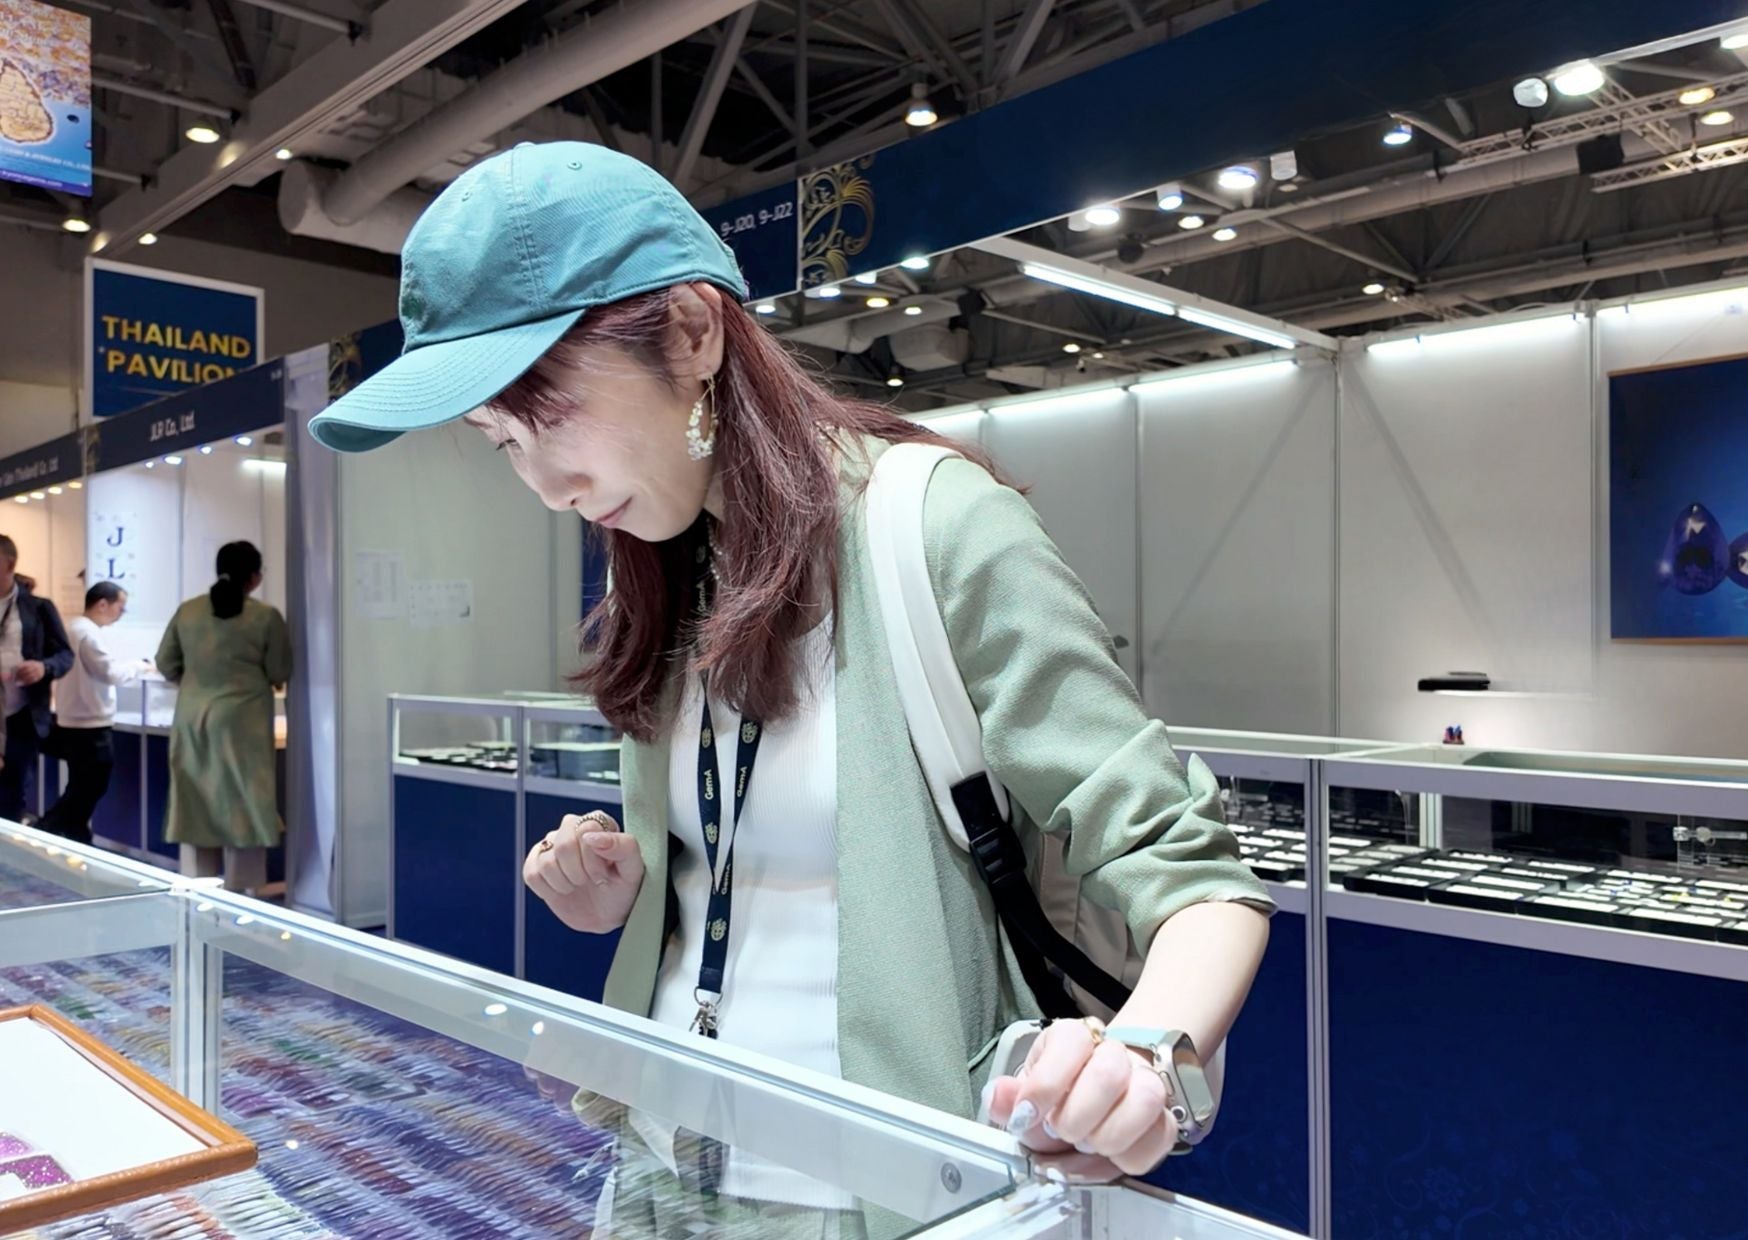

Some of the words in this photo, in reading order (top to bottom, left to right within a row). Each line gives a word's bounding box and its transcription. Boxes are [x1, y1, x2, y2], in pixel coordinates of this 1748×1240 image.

[758, 202, 793, 225] 9-J22
[102, 316, 251, 358] THAILAND
[108, 350, 236, 384] PAVILIO
[704, 768, 714, 800] GemA
[736, 766, 748, 797] GemA
